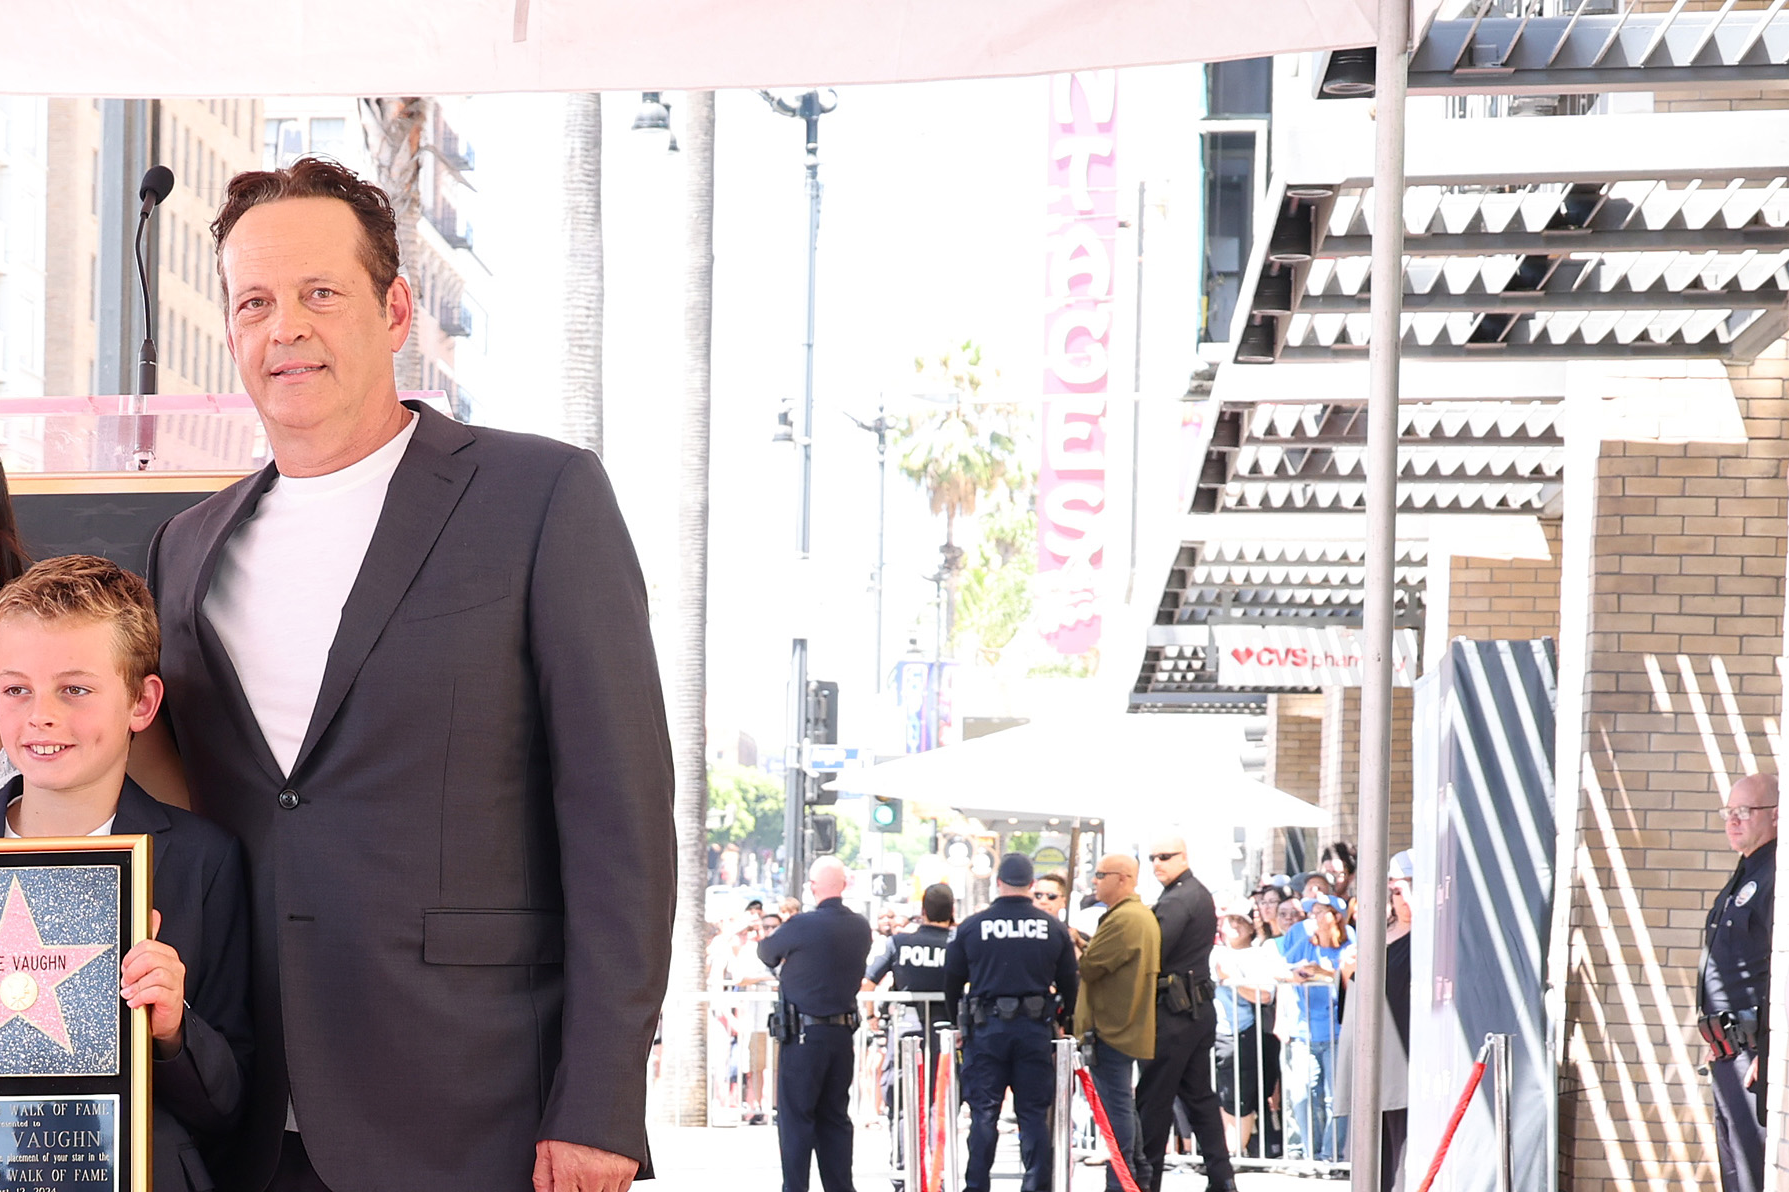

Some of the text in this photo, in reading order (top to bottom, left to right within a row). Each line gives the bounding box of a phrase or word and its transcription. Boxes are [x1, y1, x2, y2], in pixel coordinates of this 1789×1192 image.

[1256, 646, 1407, 672] CVS pharmy
[980, 918, 1049, 941] POLICE
[12, 955, 67, 971] VAUGHN
[899, 945, 947, 968] POLIC
[10, 1103, 45, 1117] WALK
[52, 1102, 68, 1116] OF
[75, 1102, 110, 1116] FAME
[32, 1120, 41, 1128] to
[11, 1130, 101, 1148] VAUGHN
[6, 1153, 40, 1165] placement
[42, 1152, 50, 1162] of
[53, 1154, 69, 1164] your
[72, 1152, 85, 1162] star
[88, 1152, 95, 1162] in
[98, 1152, 110, 1162] the
[6, 1168, 43, 1182] WALK
[51, 1168, 67, 1182] OF
[74, 1168, 108, 1182] FAME
